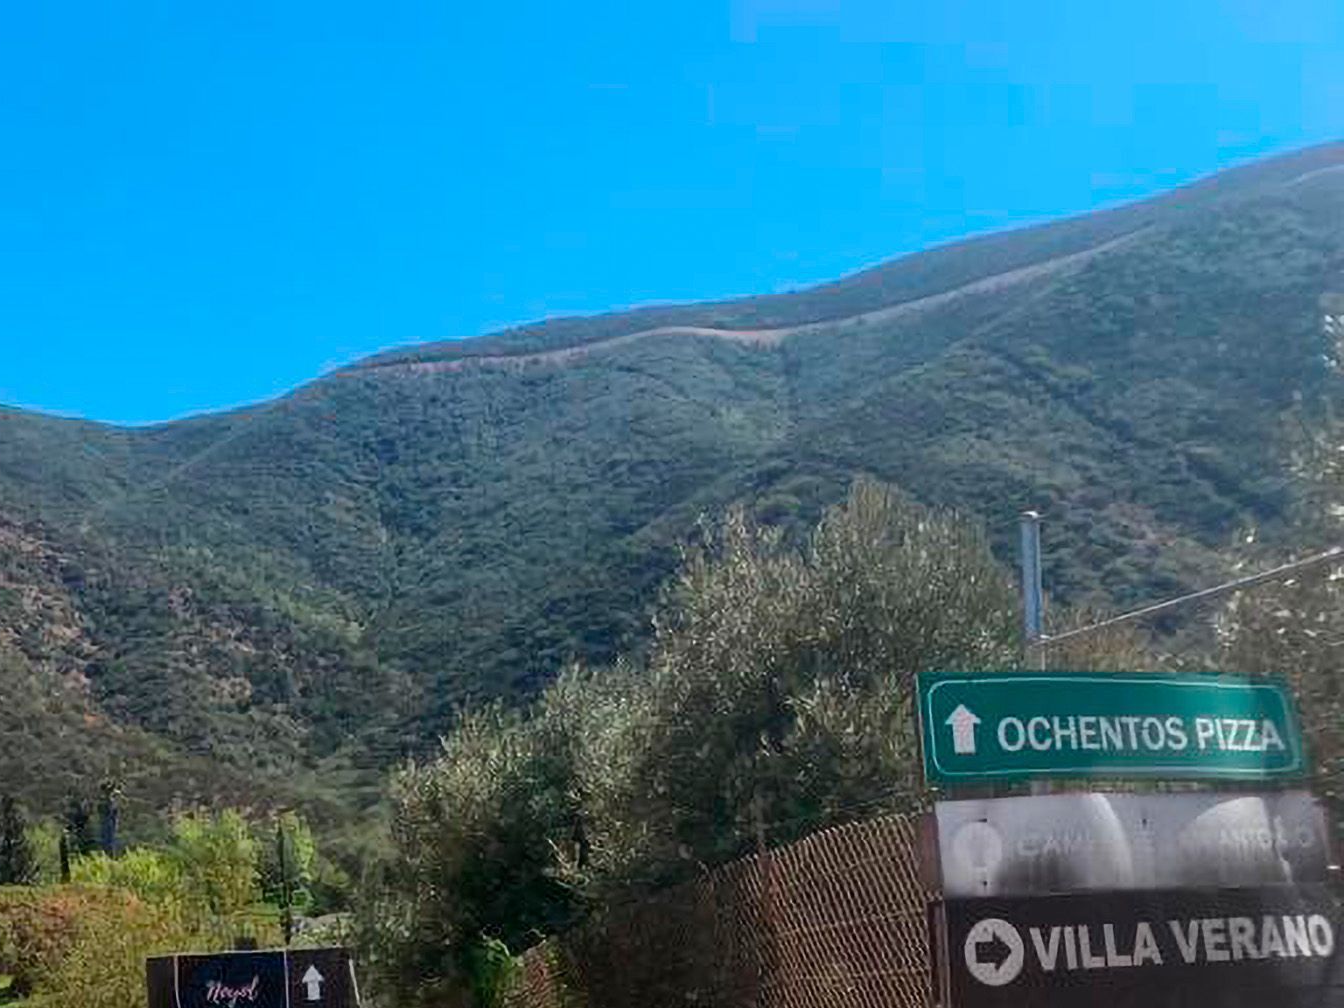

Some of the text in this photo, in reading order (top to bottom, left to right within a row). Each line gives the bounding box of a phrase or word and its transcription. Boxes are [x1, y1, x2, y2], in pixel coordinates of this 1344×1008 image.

[997, 716, 1287, 752] OCHENTOS PIZZA
[1029, 914, 1335, 971] VILLA VERANO
